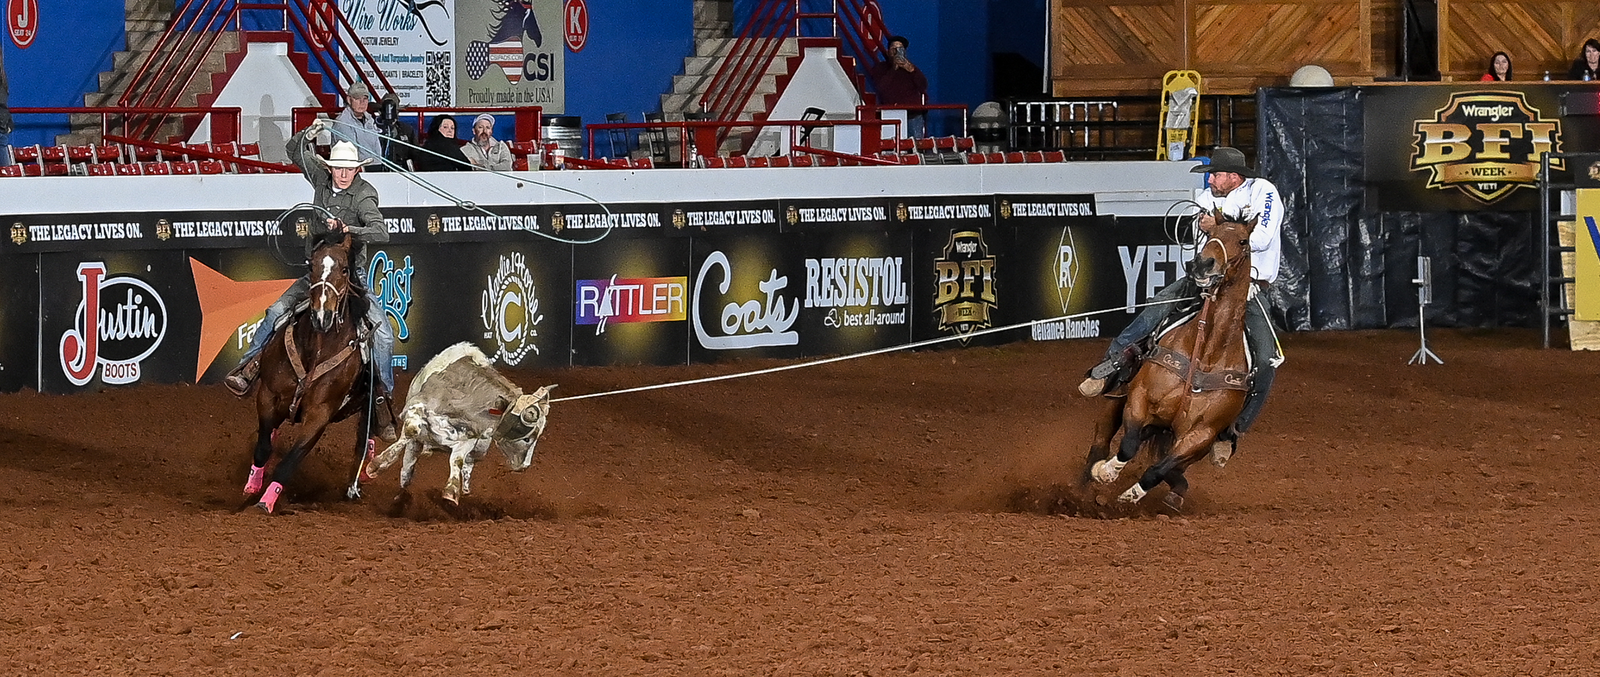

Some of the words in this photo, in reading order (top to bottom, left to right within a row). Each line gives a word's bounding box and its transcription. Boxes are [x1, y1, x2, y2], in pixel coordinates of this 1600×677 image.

[343, 0, 375, 30] Wire
[377, 0, 418, 31] Works
[570, 6, 582, 34] K
[379, 36, 399, 46] JEWELRY
[402, 70, 424, 78] BRACELETS
[523, 53, 554, 81] CSI
[468, 88, 494, 105] Proudly
[496, 88, 514, 103] made
[516, 88, 522, 103] in
[524, 88, 534, 103] the
[536, 87, 554, 103] USA!
[1462, 104, 1514, 122] Wrangler
[1416, 122, 1560, 165] BFI
[1470, 167, 1507, 177] WEEK
[1478, 182, 1498, 190] YETI
[687, 212, 704, 226] THE
[704, 211, 736, 225] LEGACY
[736, 210, 761, 224] LIVES
[762, 209, 776, 224] ON.
[799, 208, 816, 222] THE
[816, 208, 847, 222] LEGACY
[848, 207, 873, 222] LIVES
[873, 206, 887, 221] ON.
[908, 206, 923, 219] THE
[924, 205, 955, 219] LEGACY
[956, 205, 978, 219] LIVES
[978, 204, 992, 218] ON.
[1012, 203, 1027, 217] THE
[1027, 203, 1056, 216] LEGACY
[1057, 203, 1079, 216] LIVES
[1079, 203, 1093, 216] ON.
[173, 222, 195, 238] THE
[196, 221, 233, 237] LEGACY
[234, 220, 264, 236] LIVES
[265, 220, 283, 236] ON.
[400, 218, 416, 233] ON.
[442, 218, 462, 232] THE
[463, 216, 497, 232] LEGACY
[498, 216, 523, 231] LIVES
[524, 216, 540, 230] ON.
[565, 214, 583, 229] THE
[585, 213, 620, 228] LEGACY
[621, 213, 647, 228] LIVES
[647, 213, 661, 227] ON.
[29, 225, 51, 241] THE
[51, 224, 93, 240] LEGACY
[94, 223, 125, 239] LIVES
[126, 222, 143, 238] ON.
[956, 241, 977, 258] Wrangler
[804, 256, 906, 307] RESISTOL
[935, 260, 995, 305] BFI
[367, 250, 414, 340] Gist
[580, 283, 683, 317] RATTLER
[692, 250, 799, 349] Coats
[60, 262, 158, 386] Justin
[500, 291, 521, 342] C
[844, 310, 863, 326] best
[1031, 318, 1064, 341] Reliance
[1065, 316, 1100, 339] Ranches
[105, 363, 137, 378] BOOTS
